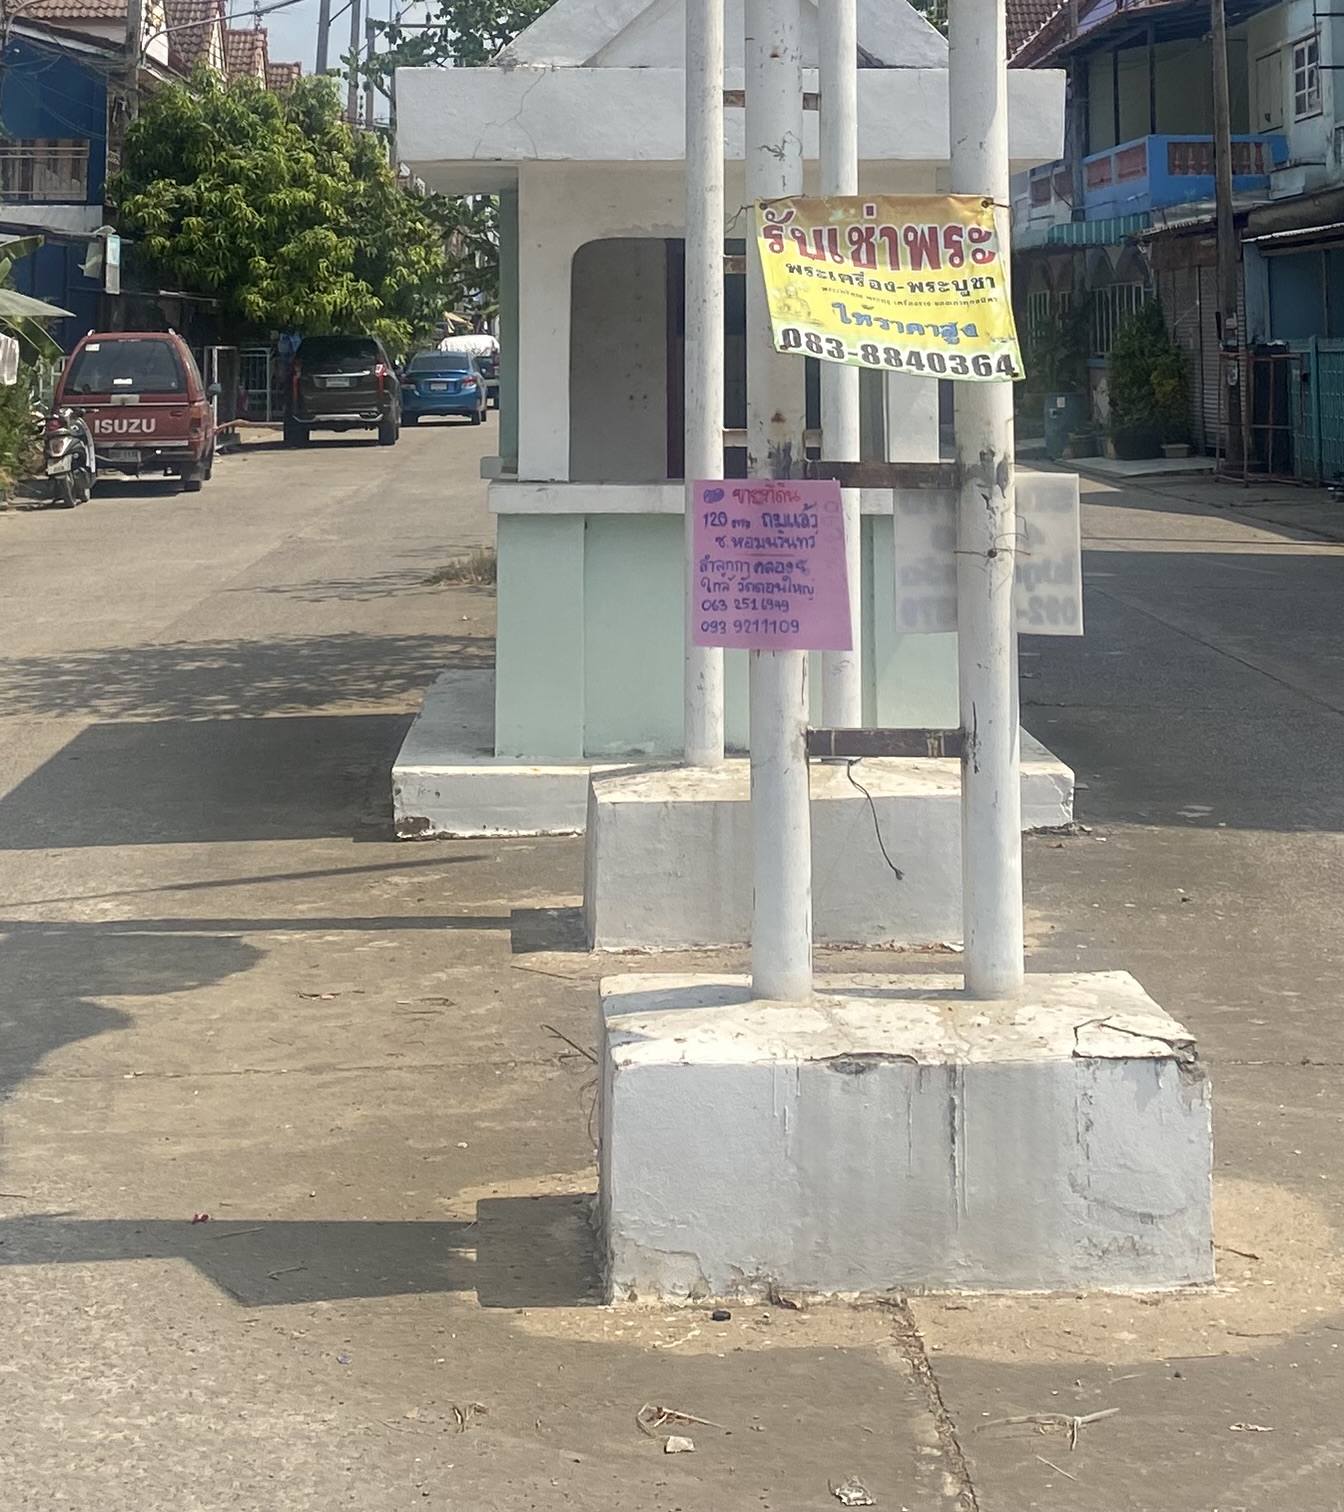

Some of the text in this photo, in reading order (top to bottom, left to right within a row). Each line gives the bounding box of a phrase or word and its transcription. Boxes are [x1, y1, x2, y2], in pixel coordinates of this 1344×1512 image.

[761, 205, 997, 271] รับเช่าพระ
[780, 328, 1016, 377] 083-8840364
[94, 418, 156, 434] ISUZU
[704, 511, 728, 528] 120
[701, 599, 728, 612] 063
[700, 619, 727, 635] 093
